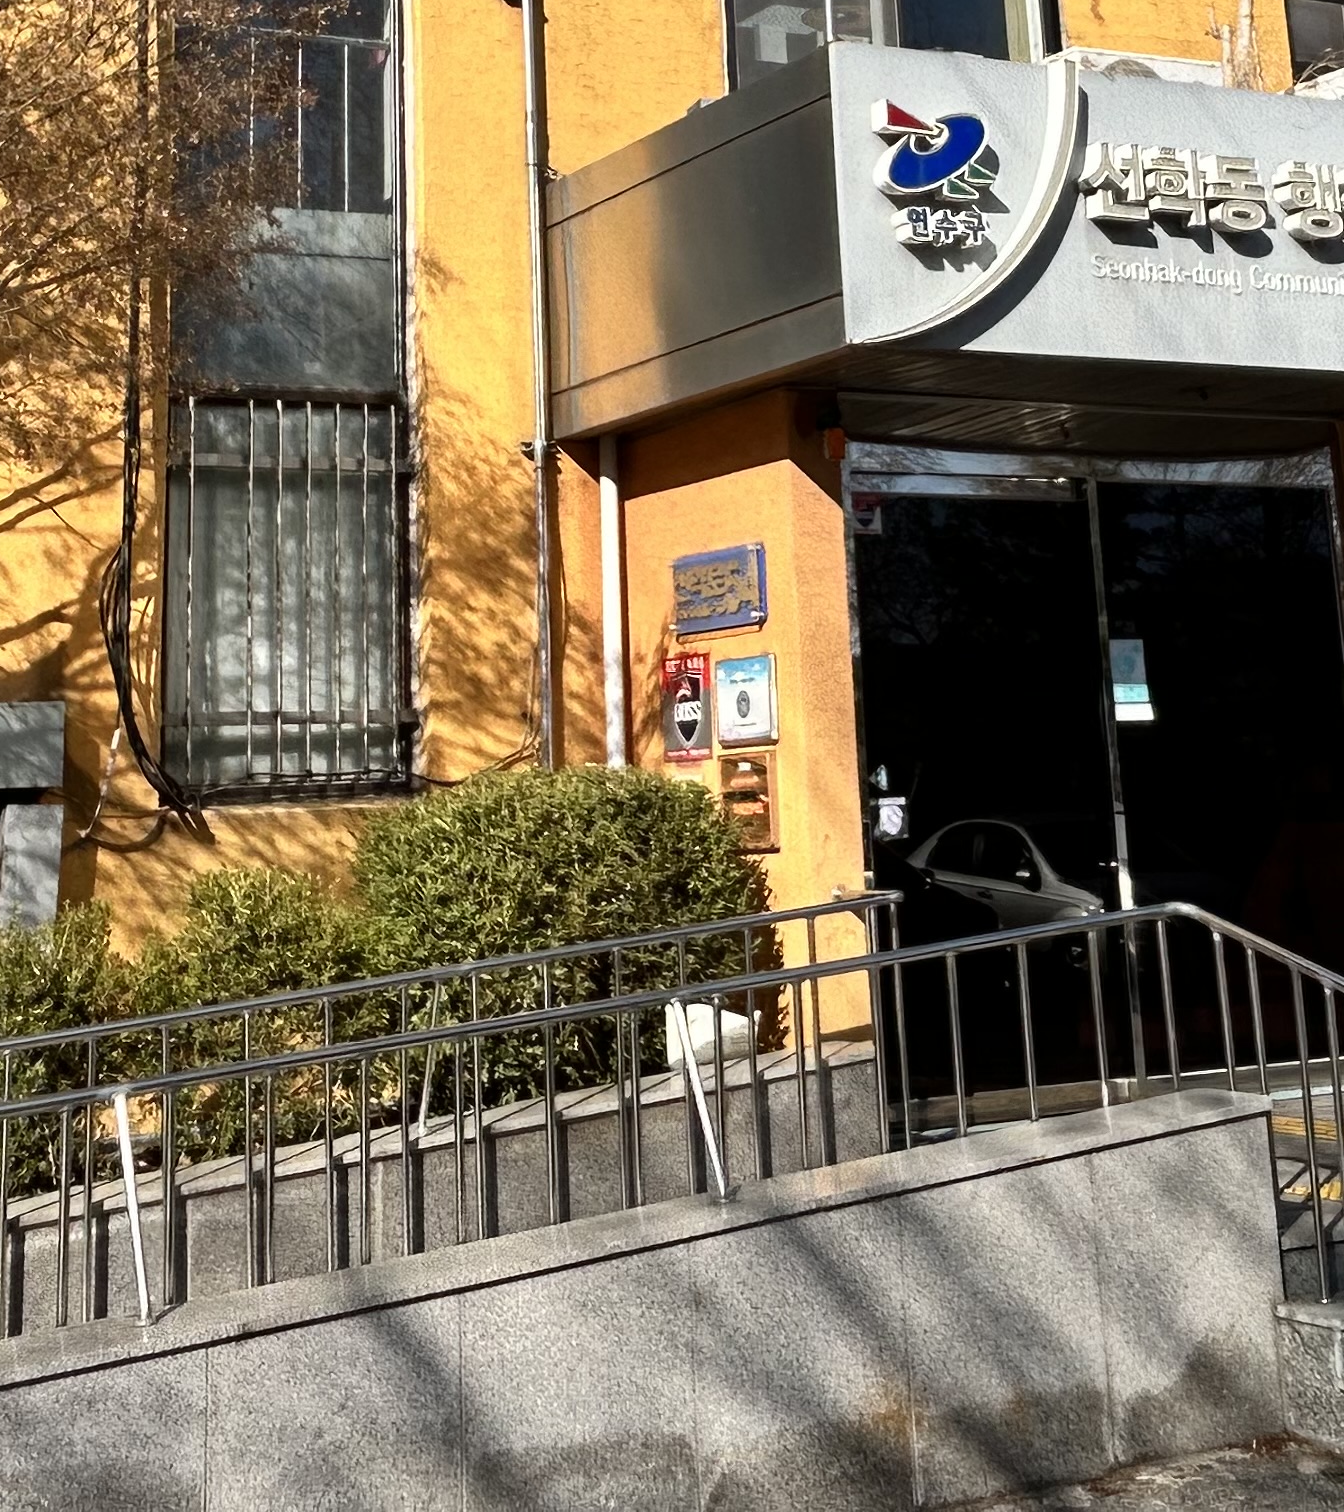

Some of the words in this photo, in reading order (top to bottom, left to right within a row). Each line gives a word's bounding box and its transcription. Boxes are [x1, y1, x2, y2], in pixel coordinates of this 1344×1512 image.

[1082, 143, 1267, 232] 선학동
[900, 206, 987, 245] 연수구
[1090, 253, 1243, 294] Seonhak-dong
